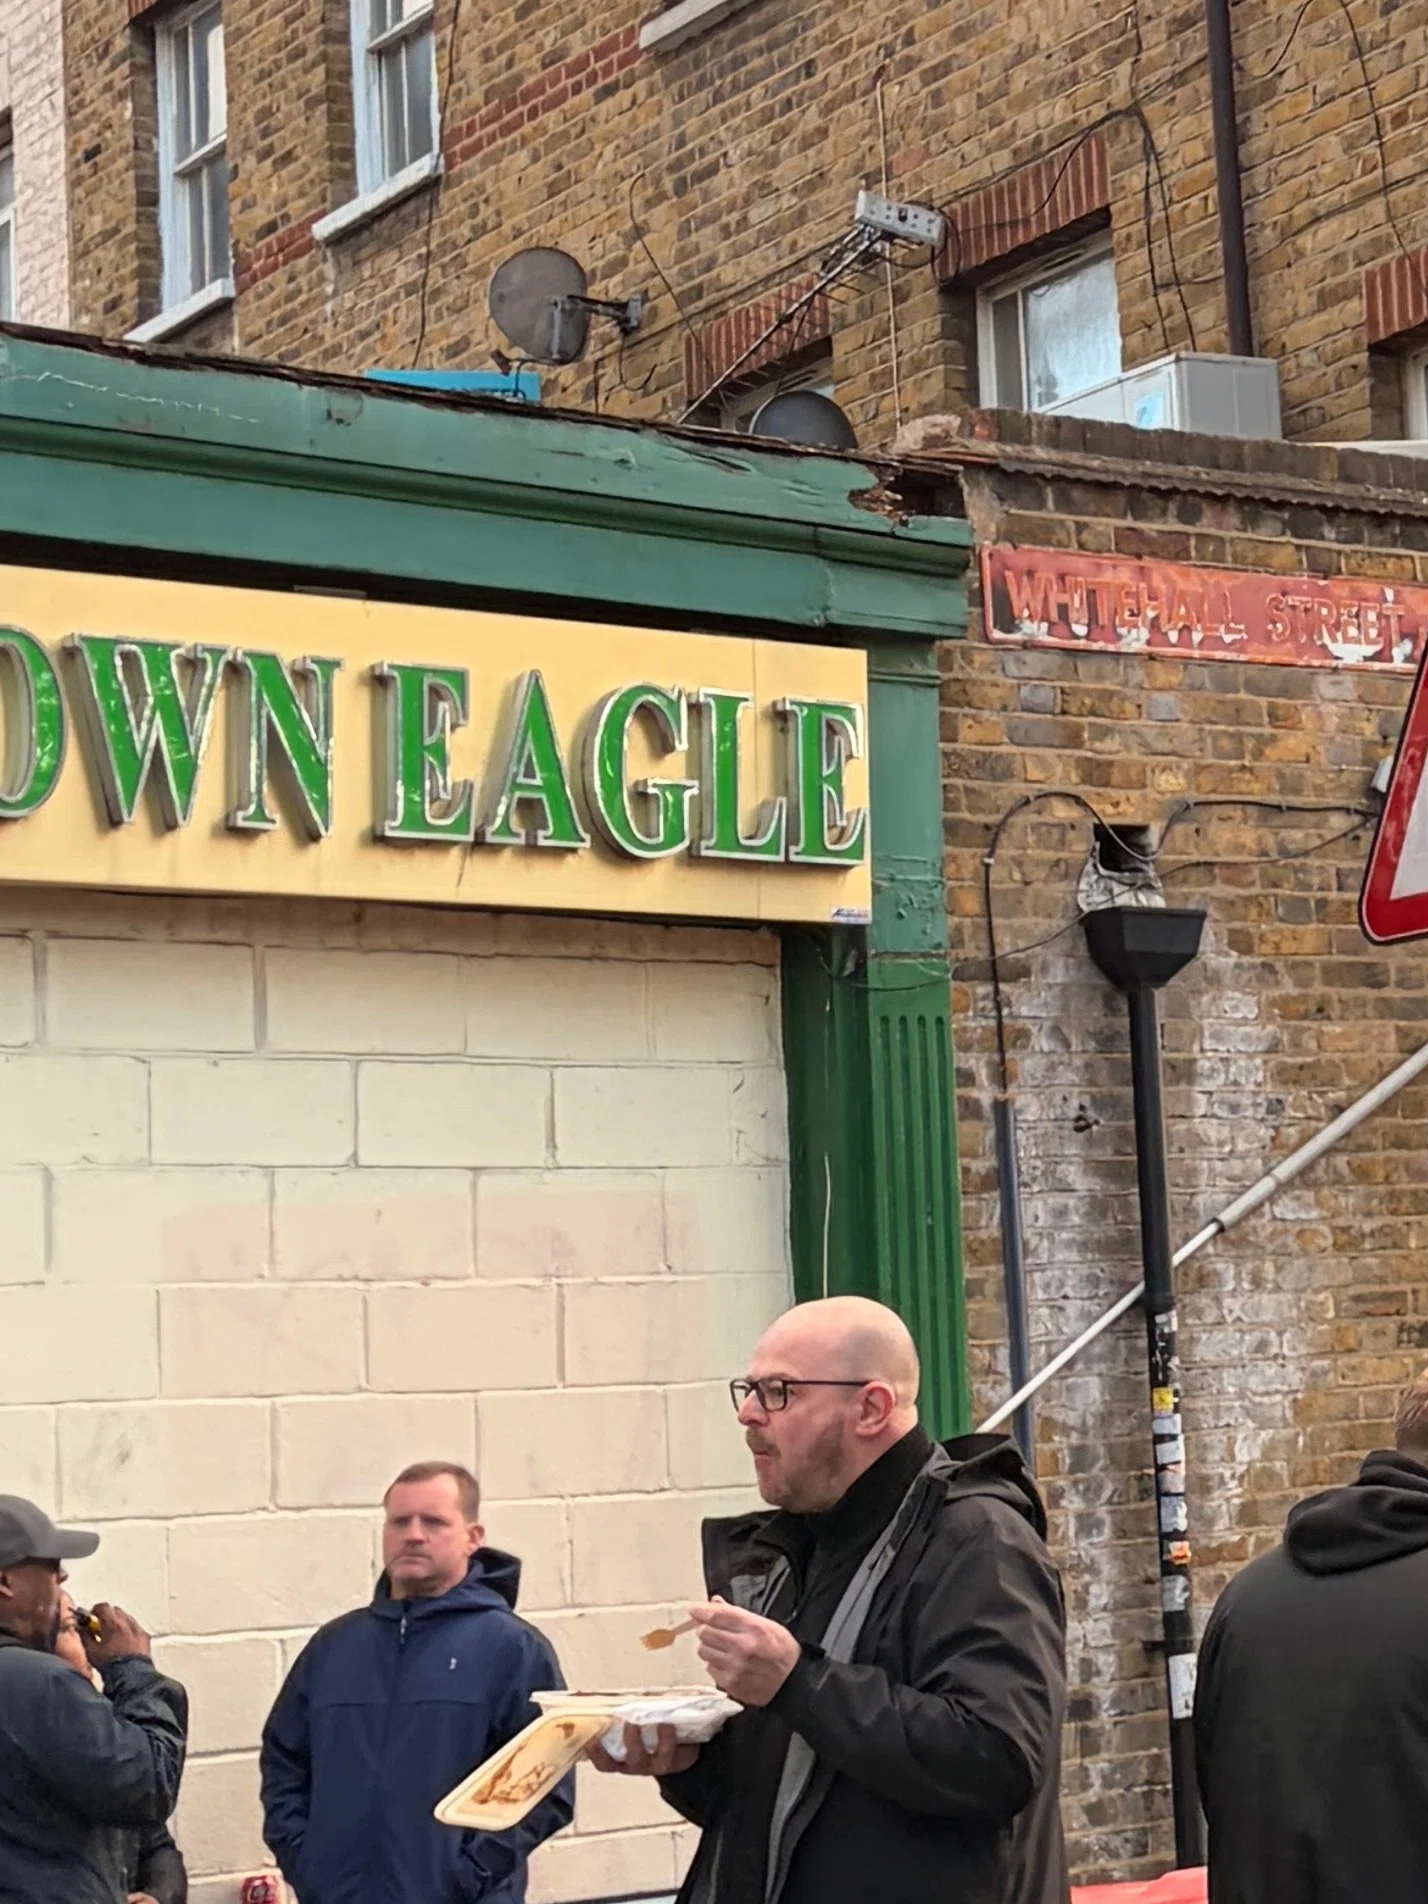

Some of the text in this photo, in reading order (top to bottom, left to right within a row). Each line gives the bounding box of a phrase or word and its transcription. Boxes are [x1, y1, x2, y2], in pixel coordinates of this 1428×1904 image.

[1004, 570, 1247, 642] WHITEHALL
[1266, 592, 1405, 659] STREET
[371, 662, 867, 866] EAGLE
